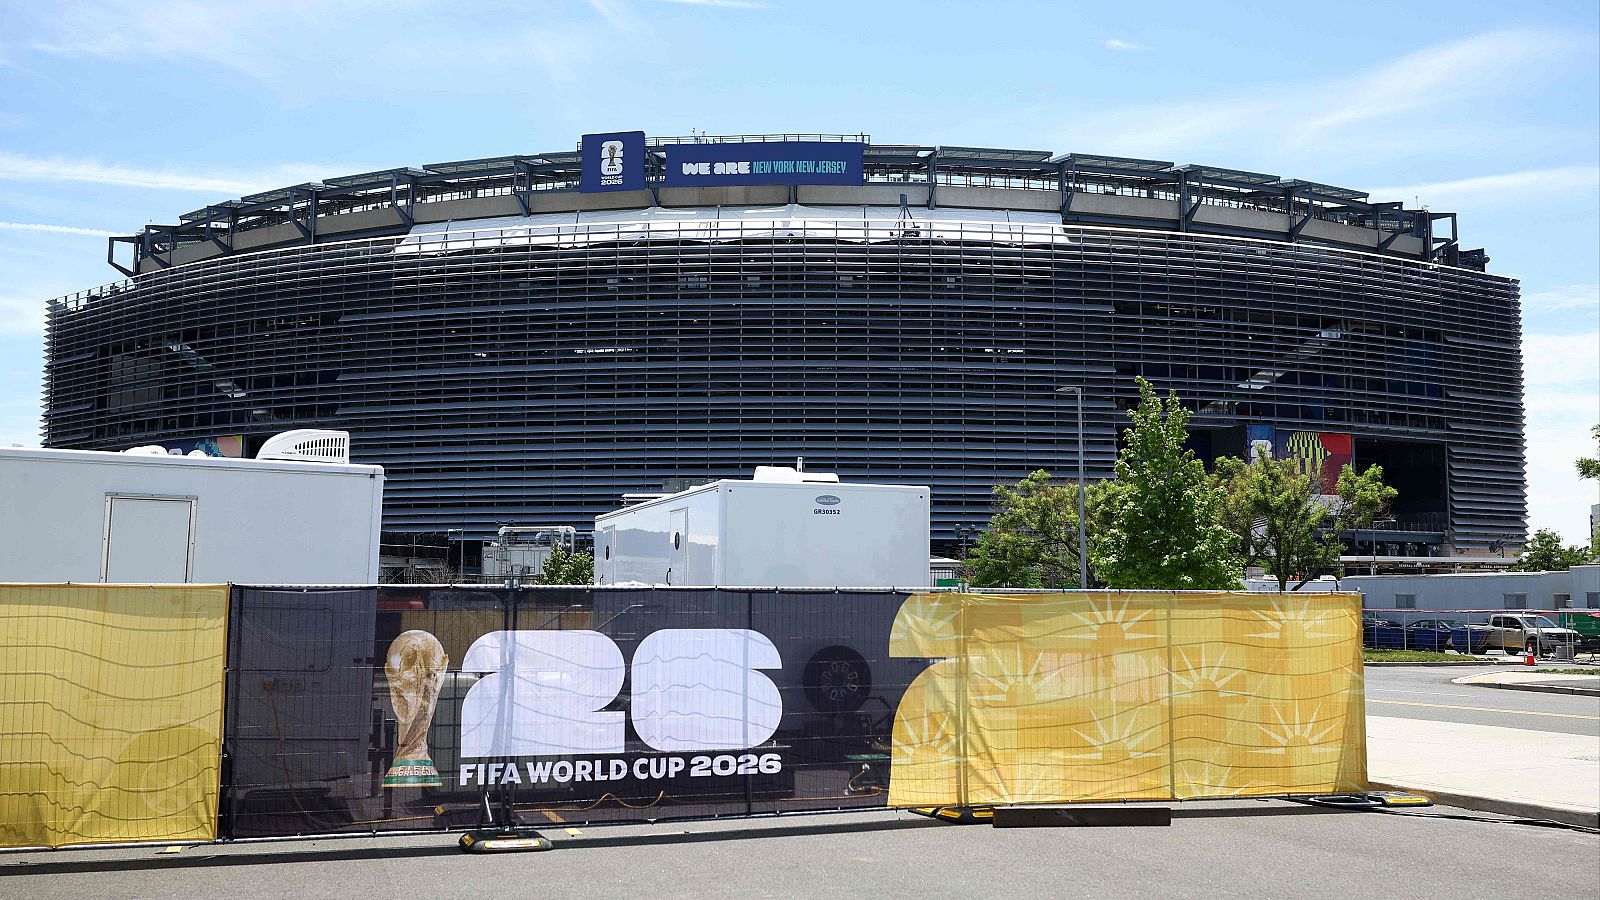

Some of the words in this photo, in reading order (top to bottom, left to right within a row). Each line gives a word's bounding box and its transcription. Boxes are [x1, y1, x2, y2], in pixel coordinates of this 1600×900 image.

[682, 162, 711, 175] WE
[752, 161, 772, 174] NEW
[773, 161, 795, 174] YORK
[796, 160, 815, 174] NEW
[459, 763, 522, 786] FIFA
[528, 758, 628, 784] WORLD
[633, 757, 685, 779] CUP
[690, 753, 782, 777] 2026
